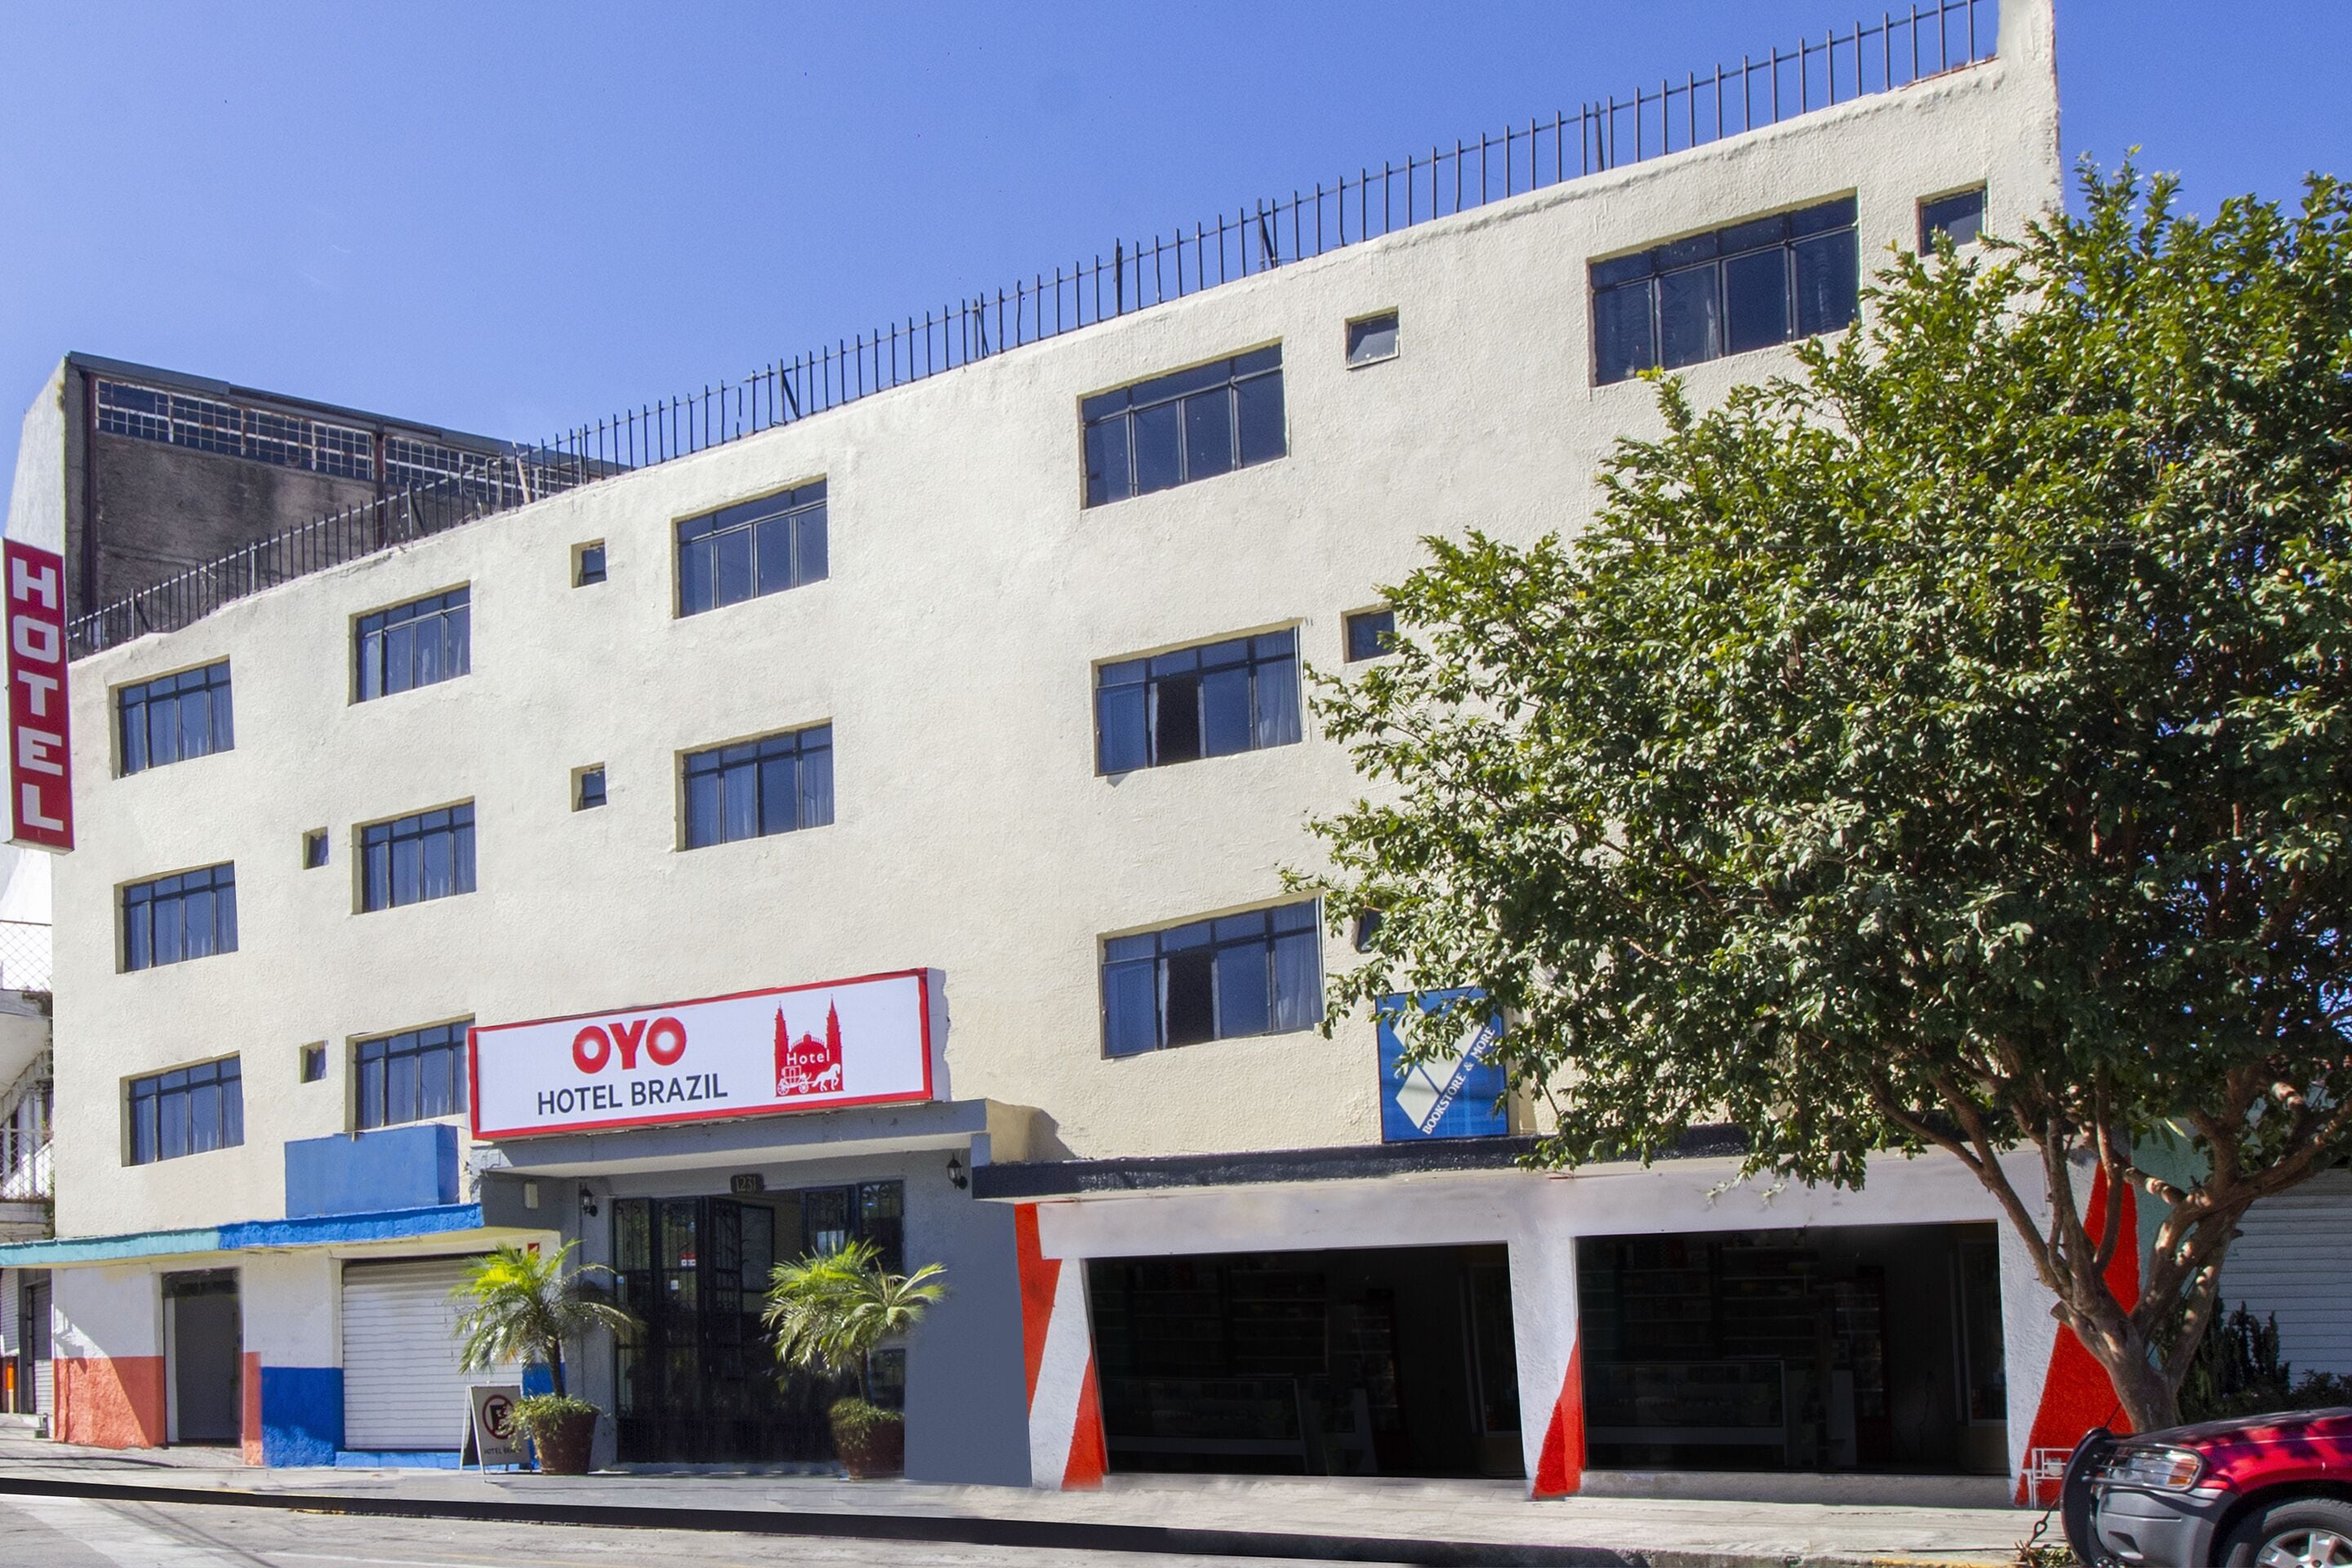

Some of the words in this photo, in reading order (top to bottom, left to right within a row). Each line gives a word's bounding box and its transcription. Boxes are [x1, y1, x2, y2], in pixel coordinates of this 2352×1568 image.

[11, 557, 65, 832] HOTEL
[572, 1016, 687, 1074] OYO
[786, 1049, 831, 1066] Hotel
[537, 1084, 623, 1116] HOTEL
[630, 1073, 728, 1107] BRAZIL
[1422, 1072, 1467, 1134] BOOKSTORE
[1463, 1061, 1475, 1071] &
[1470, 1027, 1495, 1058] MORE
